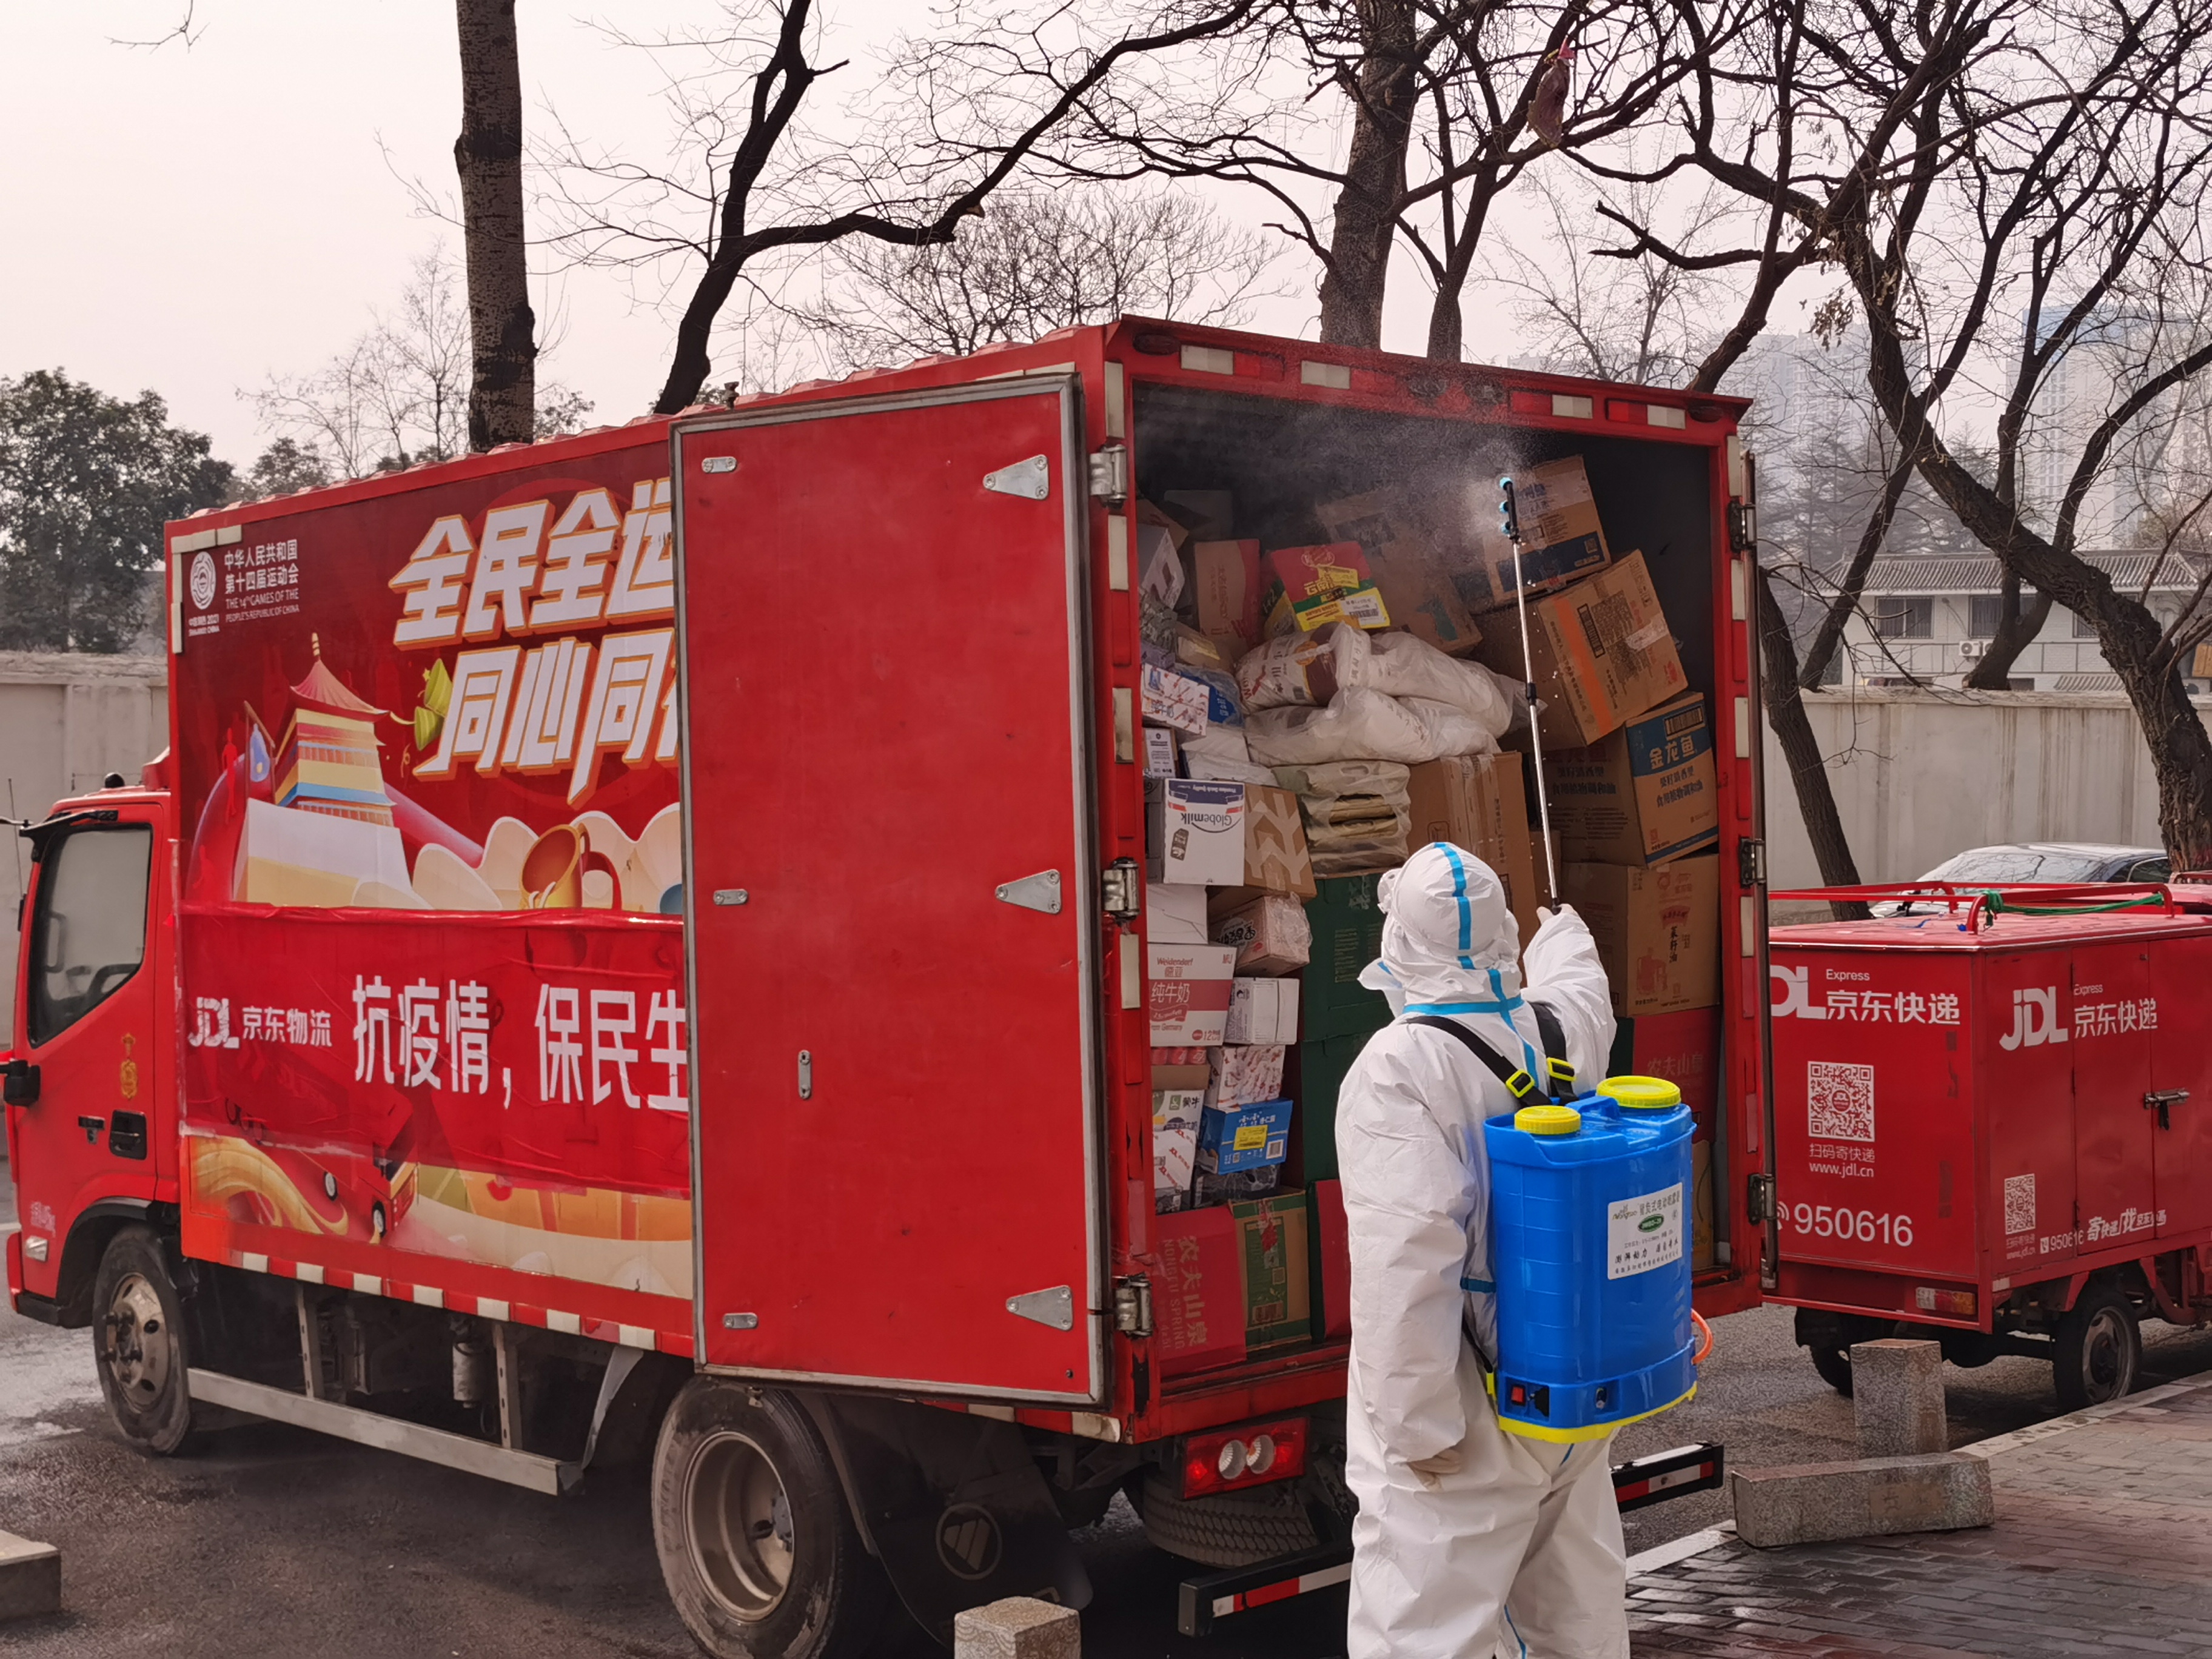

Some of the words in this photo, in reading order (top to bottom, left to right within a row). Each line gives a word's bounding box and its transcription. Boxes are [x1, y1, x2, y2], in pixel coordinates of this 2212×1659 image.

[224, 539, 298, 571] 中华人民共和国
[225, 563, 299, 594] 第十四届运动会
[251, 592, 274, 606] GAMES
[275, 591, 284, 603] OF
[285, 588, 300, 600] THE
[1649, 736, 1697, 770] 金龙鱼
[1181, 813, 1233, 826] Globemilk
[1826, 969, 1870, 982] Express
[2074, 983, 2103, 996] Express
[1151, 982, 1190, 1004] 纯牛奶
[1827, 990, 1960, 1025] 京东快递
[242, 1005, 333, 1048] 京东物流
[2074, 997, 2158, 1039] 京东快递
[1809, 1142, 1875, 1163] 扫码寄快递
[1809, 1161, 1875, 1178] www.jdl.cn
[1794, 1202, 1914, 1247] 950616
[2049, 1229, 2085, 1251] 950616
[1178, 1235, 1208, 1347] 农夫山泉
[1171, 1299, 1185, 1350] SPRING
